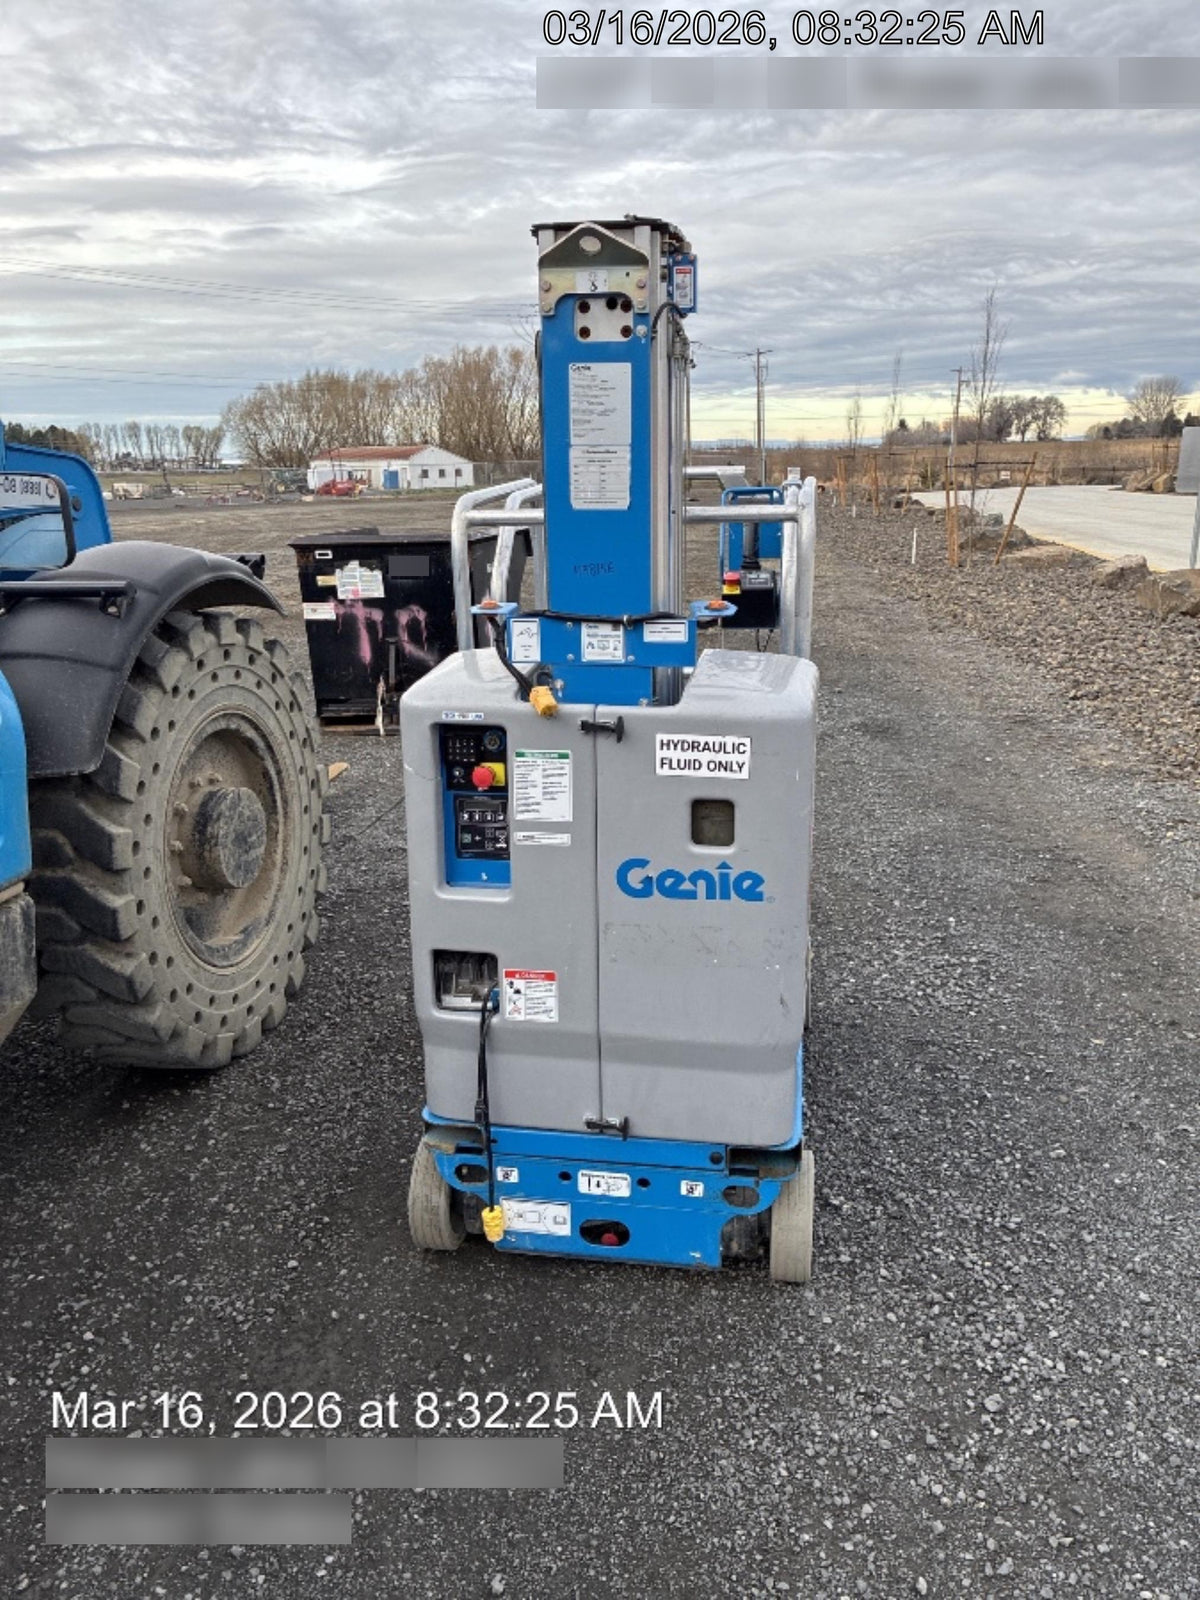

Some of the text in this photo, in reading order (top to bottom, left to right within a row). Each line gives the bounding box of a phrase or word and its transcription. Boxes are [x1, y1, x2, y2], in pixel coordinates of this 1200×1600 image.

[660, 739, 747, 755] HYDRAULIC
[660, 757, 746, 774] FLUID ONLY
[616, 857, 766, 902] Genie
